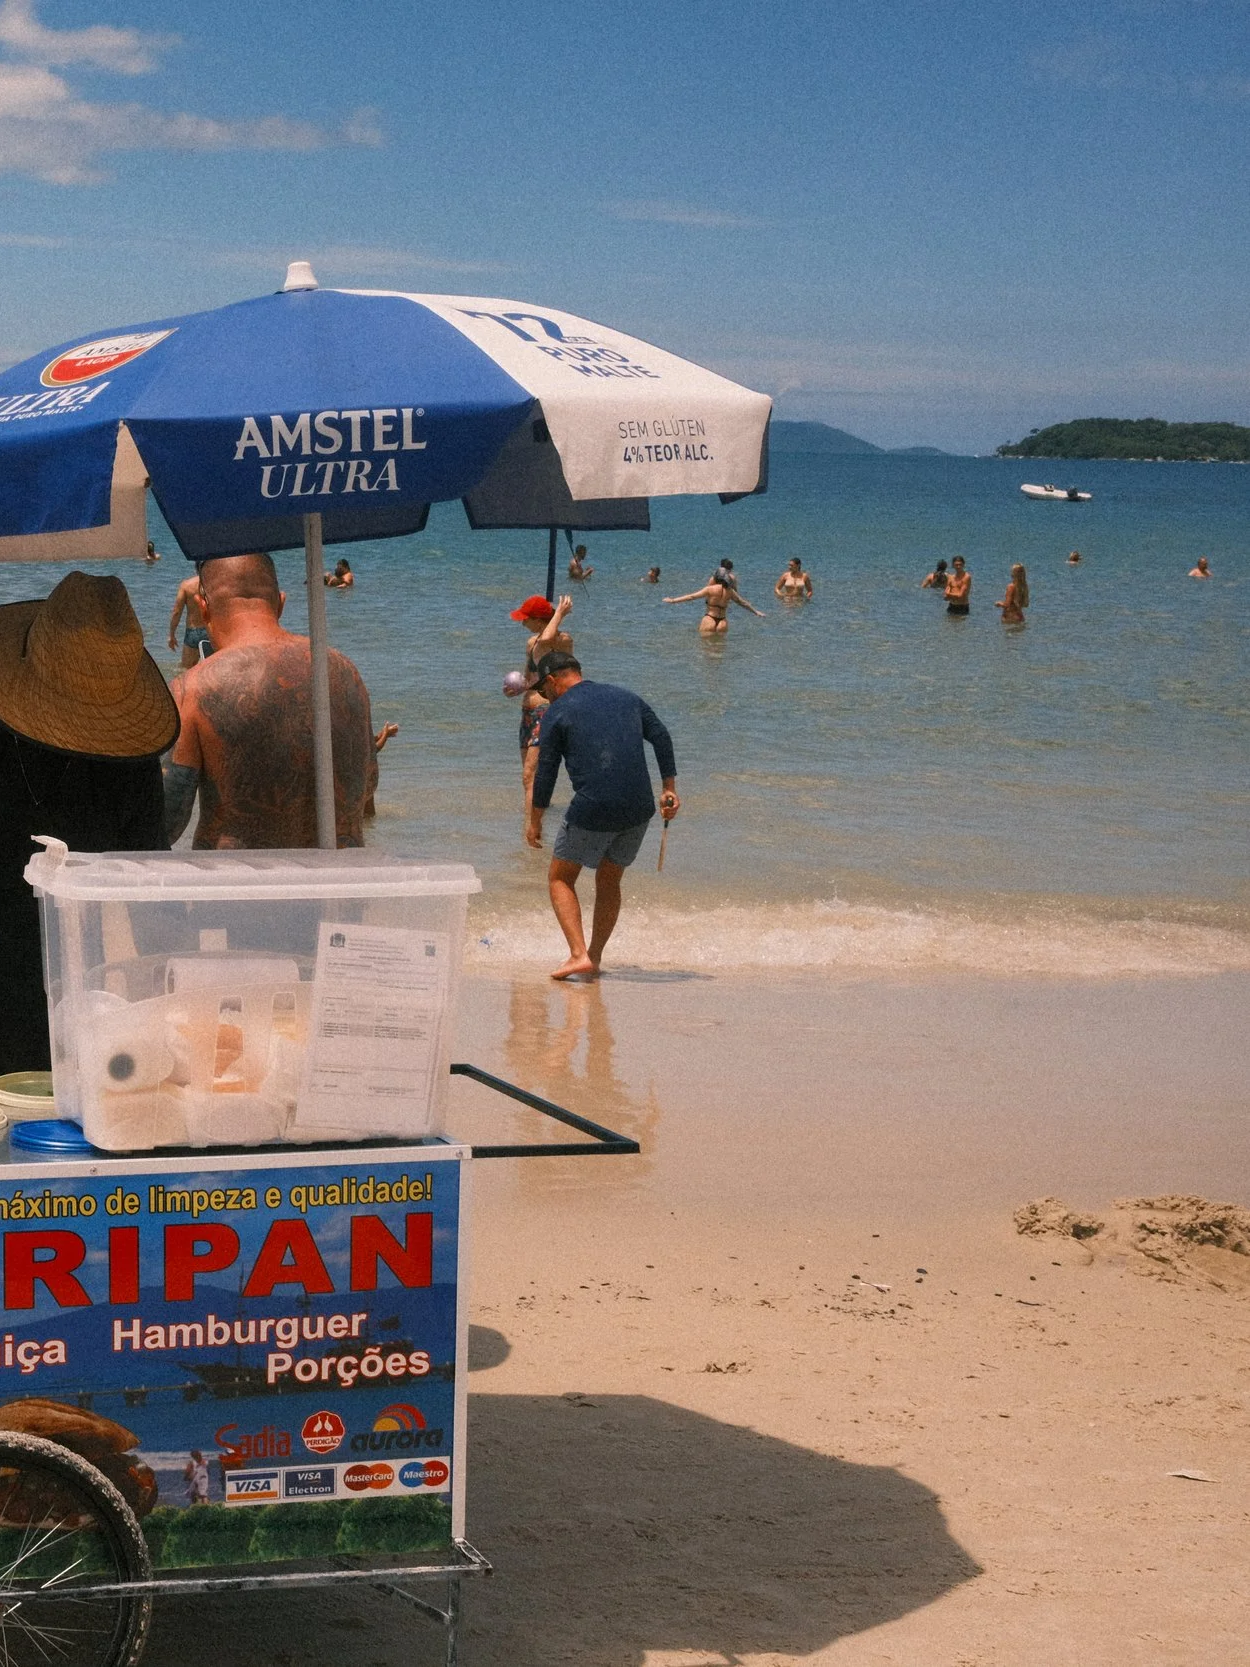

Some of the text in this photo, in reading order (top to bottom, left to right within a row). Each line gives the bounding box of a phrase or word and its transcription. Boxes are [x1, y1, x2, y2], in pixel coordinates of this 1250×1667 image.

[455, 308, 570, 343] 72
[536, 346, 629, 363] PURO
[569, 364, 661, 378] MALTE
[12, 411, 43, 421] PURO
[43, 405, 81, 416] MALTE
[233, 408, 427, 460] AMSTEL
[618, 415, 706, 439] SEM GLÚTEN
[623, 444, 714, 463] 4% TEOR ALC.
[260, 458, 400, 498] ULTRA
[105, 1187, 140, 1215] de
[149, 1185, 257, 1218] limpeza
[266, 1189, 281, 1209] e
[290, 1173, 433, 1213] qualidade!
[112, 1312, 368, 1351] Hamburguer
[266, 1347, 430, 1387] Porções
[214, 1423, 291, 1463] Sadia
[306, 1436, 341, 1446] PERDIGÃO
[350, 1428, 444, 1453] aurora
[297, 1471, 321, 1481] VISA
[345, 1470, 394, 1483] MasterCard
[403, 1468, 444, 1479] Maestro
[235, 1479, 271, 1492] VISA
[288, 1485, 331, 1496] Electron
